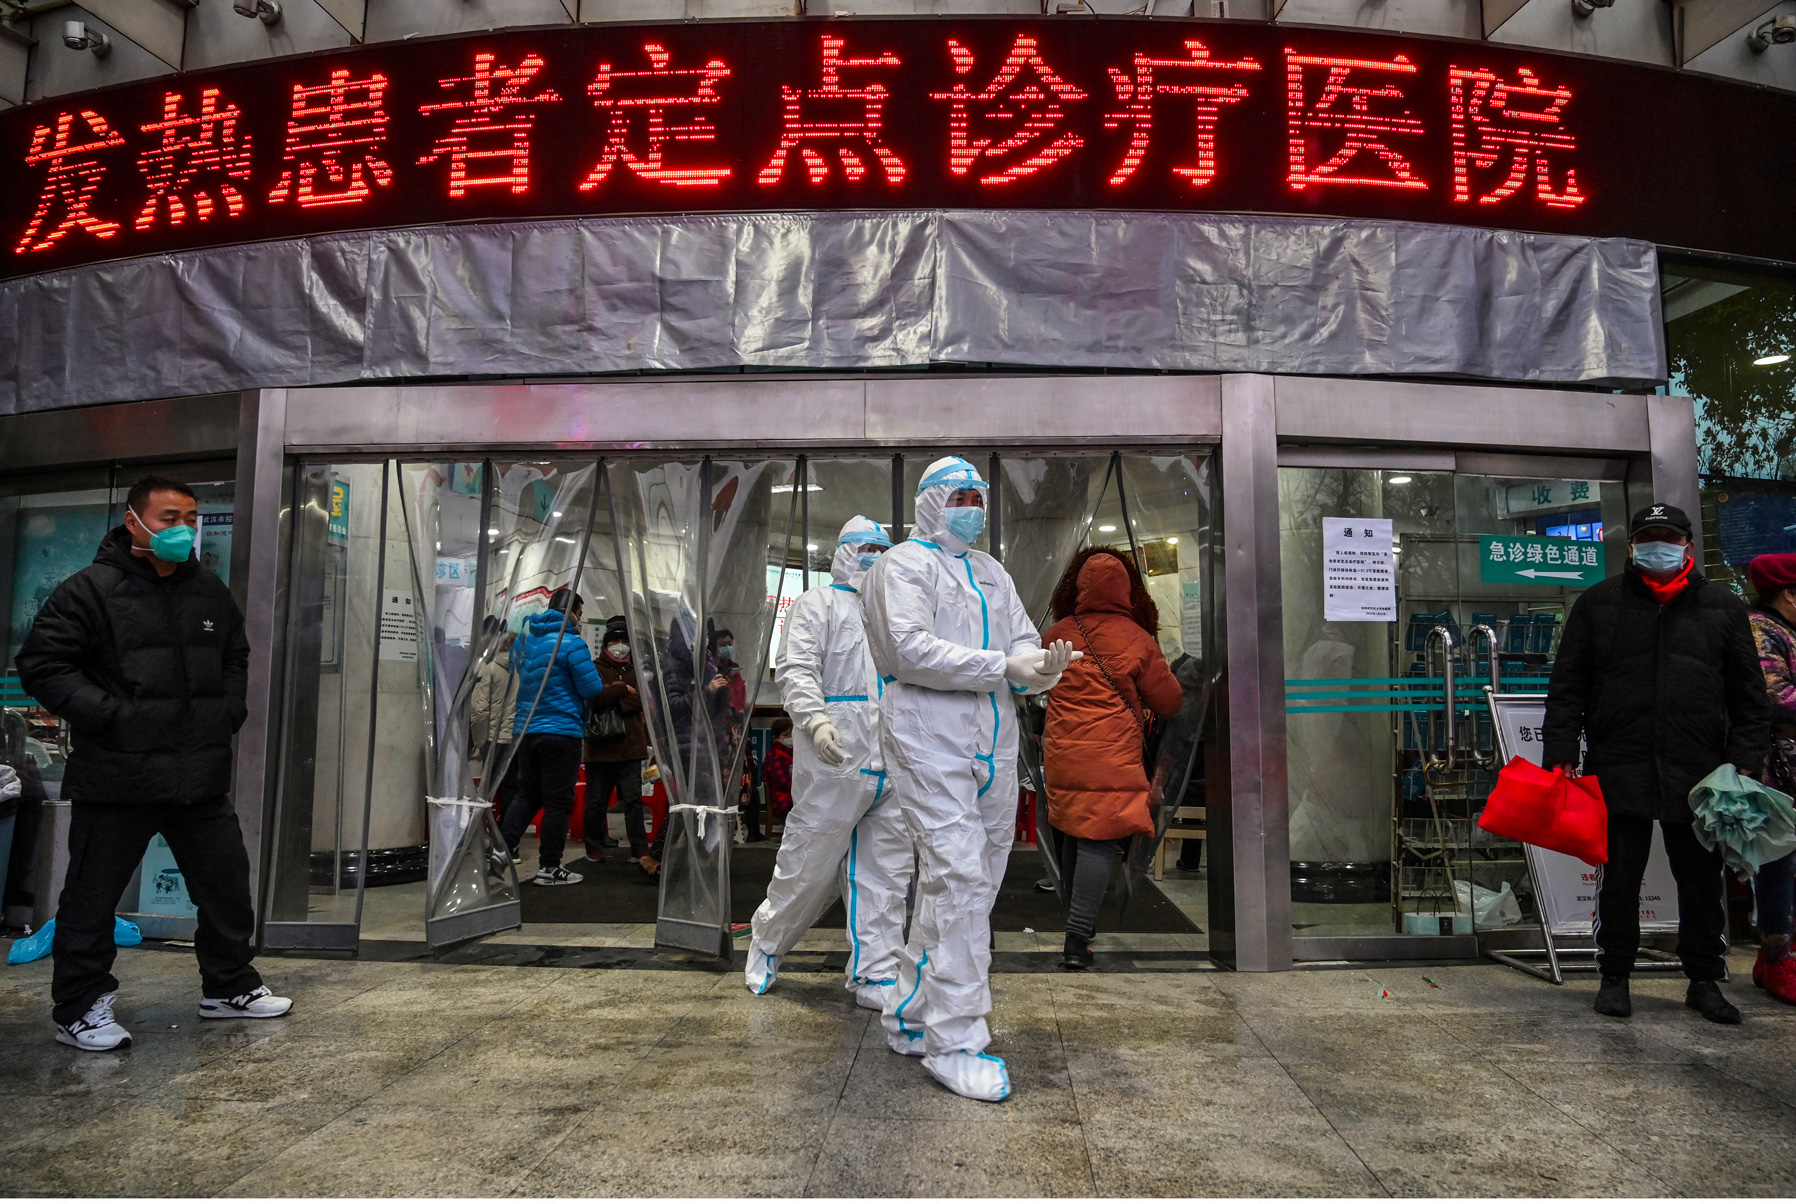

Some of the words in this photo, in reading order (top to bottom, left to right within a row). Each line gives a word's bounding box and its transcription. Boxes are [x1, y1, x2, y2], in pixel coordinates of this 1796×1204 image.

[15, 36, 1585, 254] 发热患者定点诊疗医院
[1532, 480, 1590, 506] 收费
[1343, 527, 1374, 538] 通知
[1489, 541, 1599, 567] 急诊绿色通道
